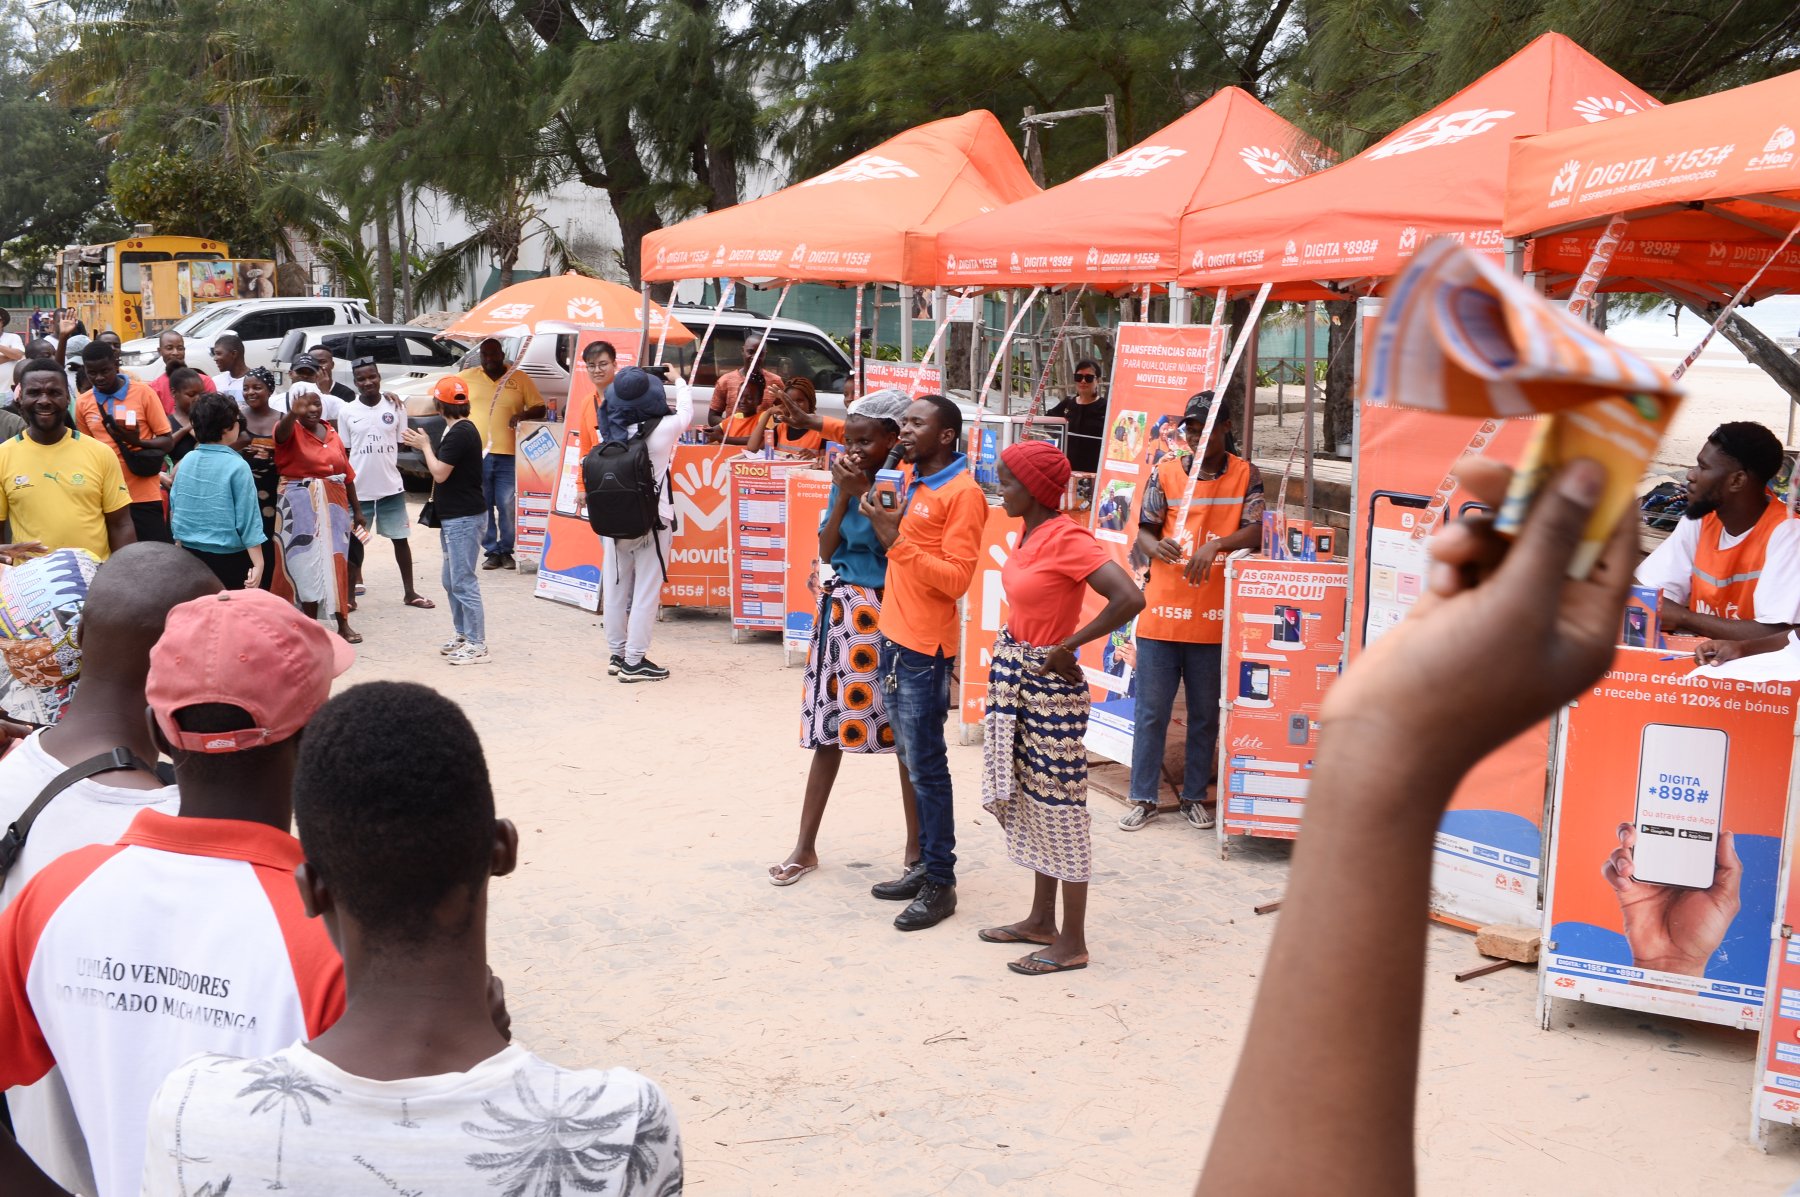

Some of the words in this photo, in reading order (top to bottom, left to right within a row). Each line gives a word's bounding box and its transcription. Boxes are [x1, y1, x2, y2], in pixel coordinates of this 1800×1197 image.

[1748, 152, 1793, 166] e-Mola
[1585, 157, 1657, 188] DIGITA
[1627, 178, 1666, 192] MELHORES
[1666, 169, 1718, 185] PROMOÇÕES
[1304, 243, 1340, 257] DIGITA
[808, 251, 839, 264] DIGITA
[1024, 257, 1047, 268] DIGITA
[1101, 253, 1131, 264] DIGITA
[1208, 253, 1236, 267] DIGITA
[1121, 344, 1185, 357] TRANSFERÊNCIAS
[1123, 359, 1140, 369] PARA
[1141, 362, 1177, 372] QUALQUER
[1178, 362, 1207, 373] NÚMERO
[1136, 373, 1166, 385] MOVITEL
[527, 433, 547, 452] DIGITA
[797, 482, 820, 490] Compra
[670, 547, 728, 564] MOVIT
[1243, 571, 1257, 580] AS
[1260, 572, 1309, 583] GRANDES
[1240, 583, 1273, 596] ESTÃO
[1276, 585, 1323, 598] AQUI!
[1651, 671, 1708, 688] crédito
[1712, 677, 1732, 691] via
[1735, 680, 1792, 696] e-Mola
[1593, 687, 1602, 696] e
[1605, 687, 1651, 702] recebe
[1654, 691, 1677, 704] até
[1680, 693, 1721, 708] 120%
[1723, 697, 1742, 710] de
[1745, 699, 1790, 715] bónus
[1232, 734, 1264, 749] elite
[1659, 773, 1701, 787] DIGITA
[1642, 809, 1653, 817] Ou
[1655, 811, 1685, 821] através
[1699, 816, 1716, 825] App
[77, 957, 126, 981] UNIÃO
[131, 964, 231, 998] VENDEDORES
[77, 987, 158, 1013] MERCADO
